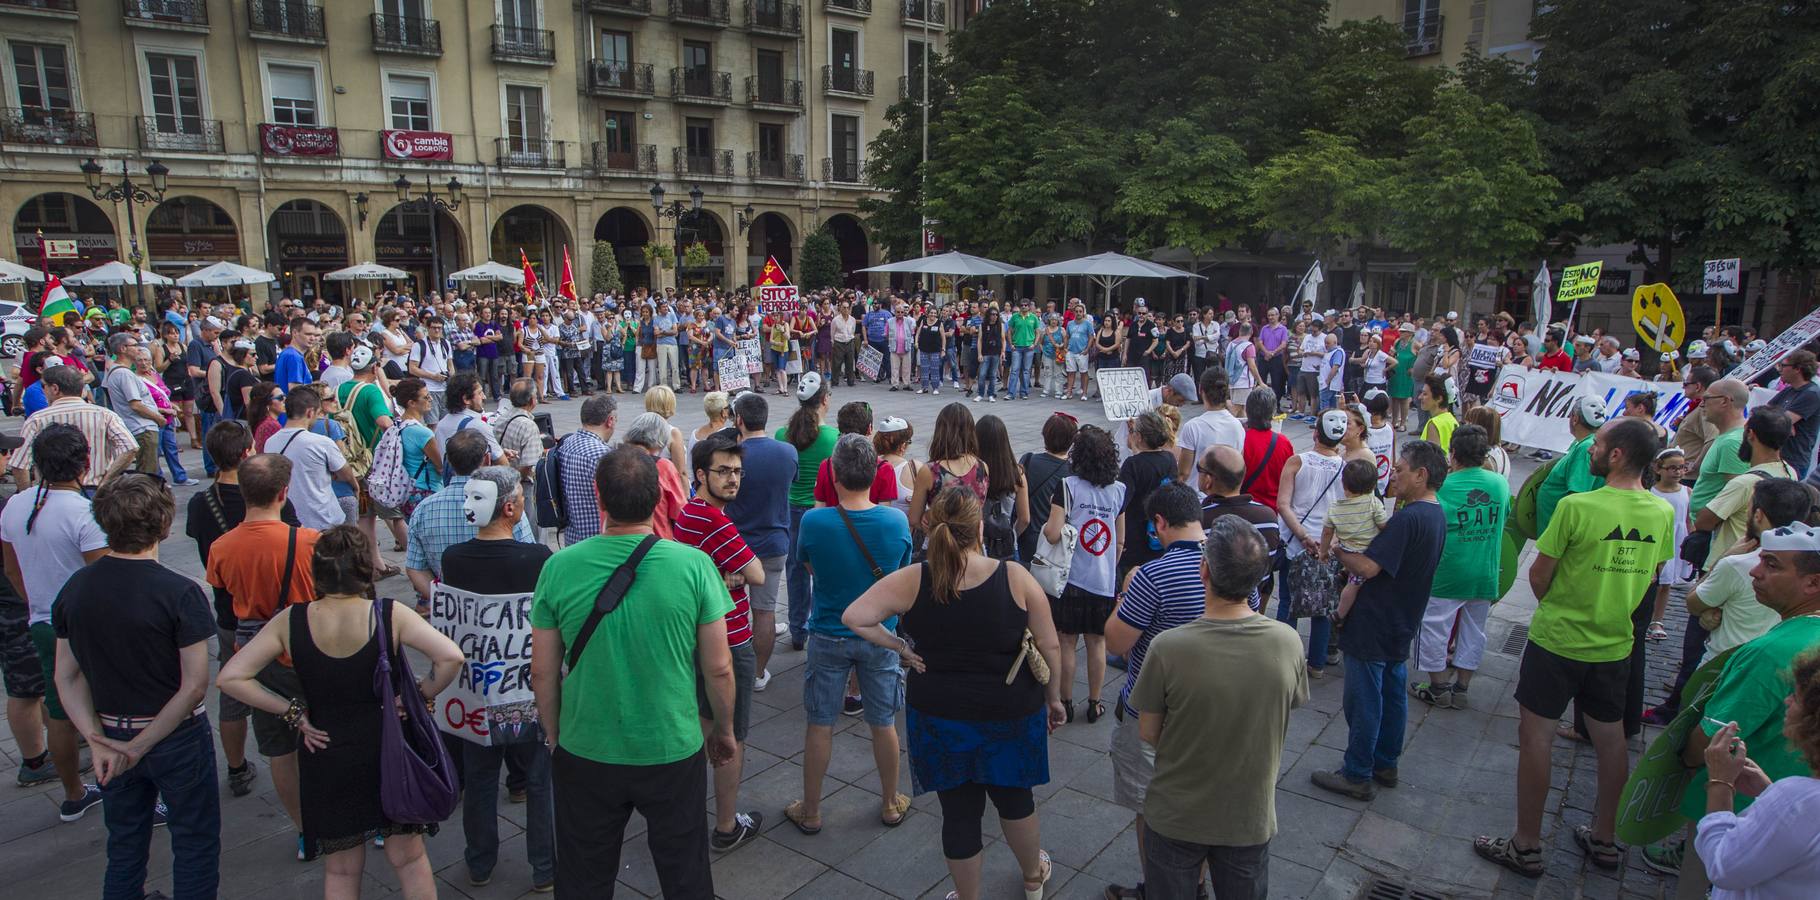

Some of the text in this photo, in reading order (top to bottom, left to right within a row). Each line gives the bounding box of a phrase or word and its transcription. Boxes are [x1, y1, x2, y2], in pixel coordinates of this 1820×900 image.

[414, 137, 448, 146] cambia
[1580, 266, 1600, 280] NO
[761, 287, 797, 301] STOP
[1559, 285, 1596, 297] PASANDO
[1457, 506, 1499, 529] PAH
[1617, 546, 1637, 555] BTT
